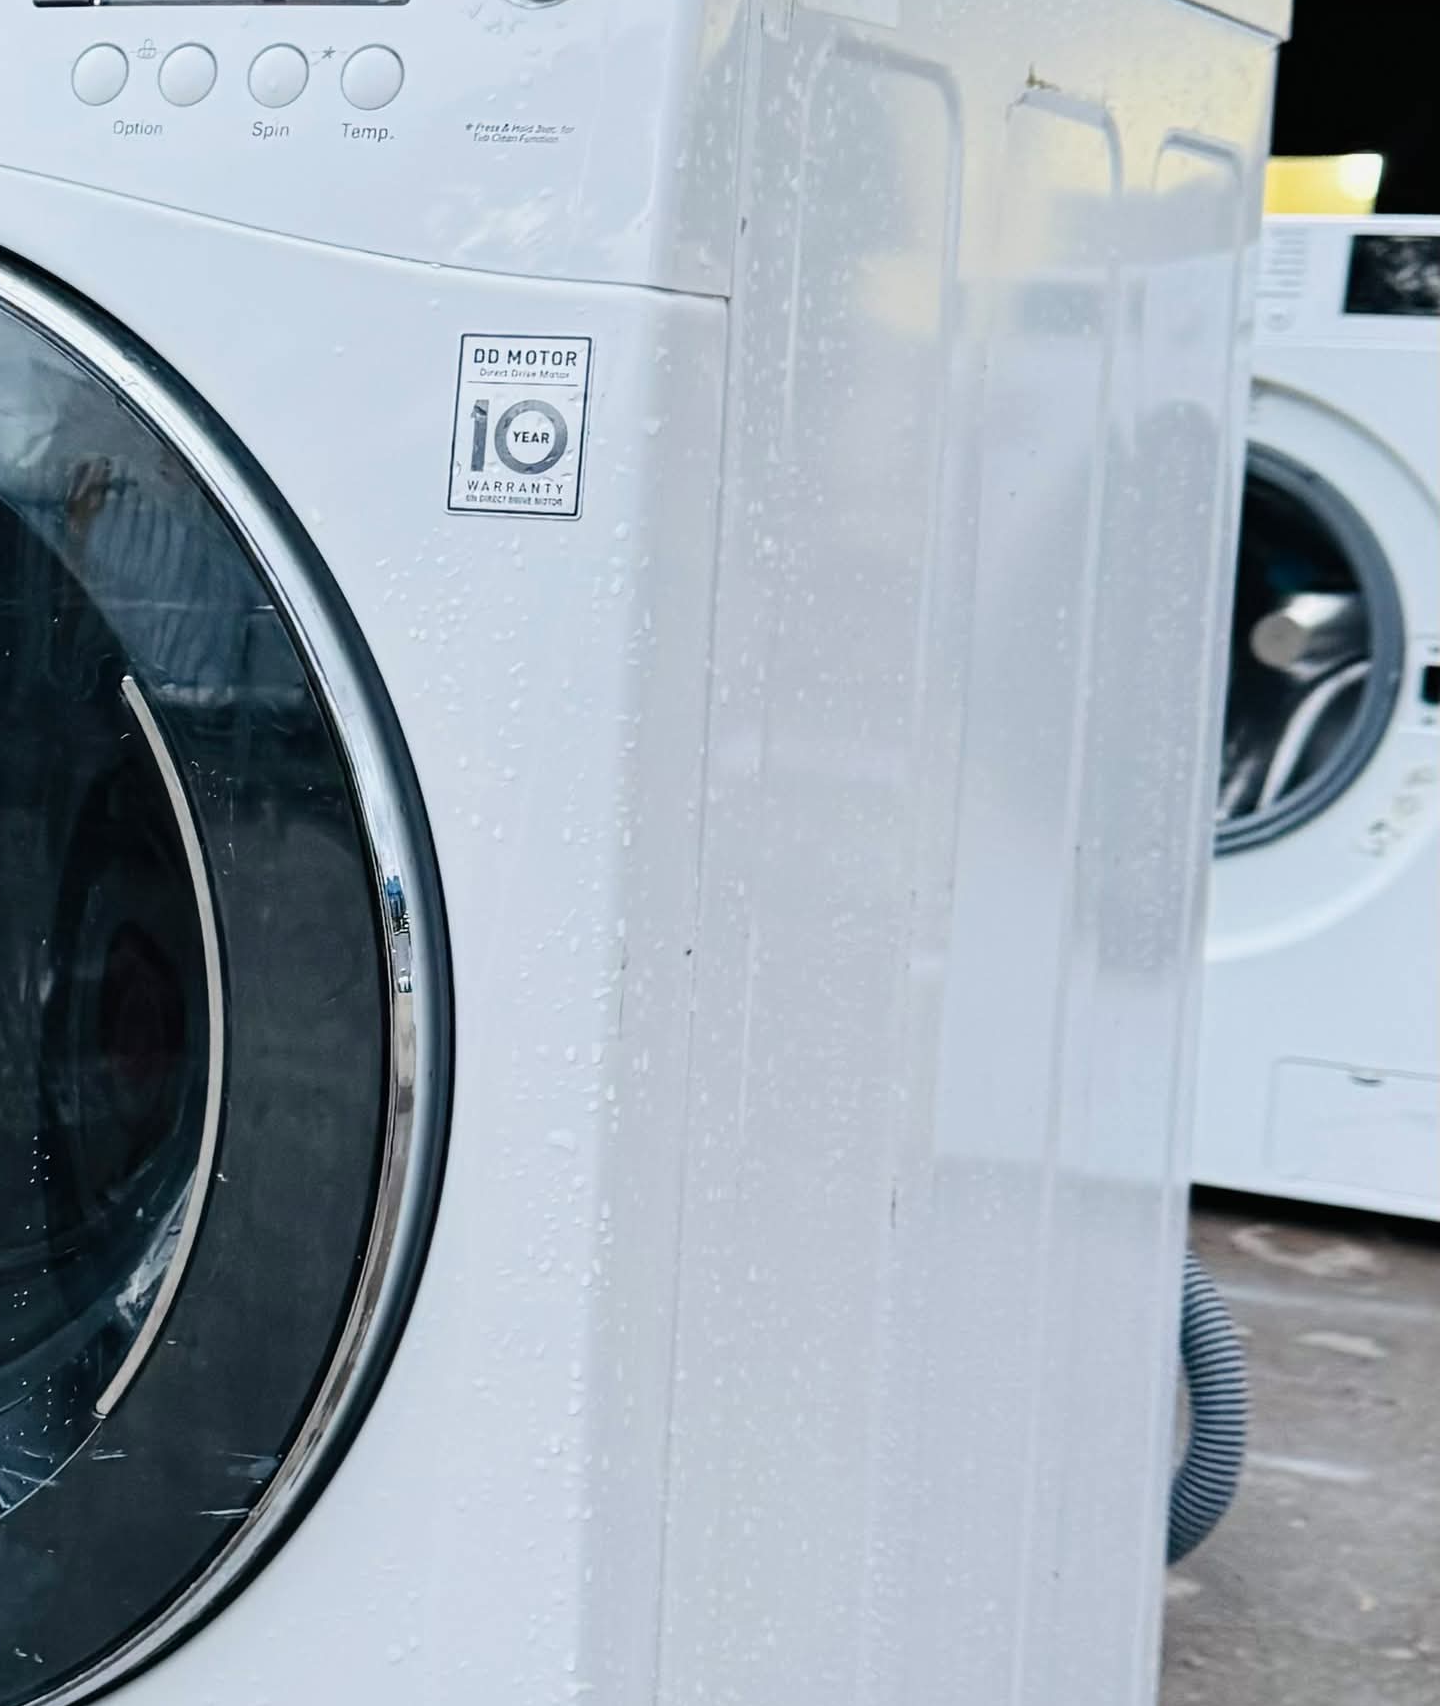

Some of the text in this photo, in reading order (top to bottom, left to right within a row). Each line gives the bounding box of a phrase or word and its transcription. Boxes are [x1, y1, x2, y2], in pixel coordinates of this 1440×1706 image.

[112, 120, 163, 137] Option
[251, 121, 290, 138] Spin
[342, 123, 395, 142] Temp.
[474, 348, 577, 367] DD MOTOR
[480, 368, 570, 380] Direct Drive Motor
[470, 399, 568, 475] 10
[513, 431, 550, 444] YEAR
[467, 480, 564, 495] WARRANTY
